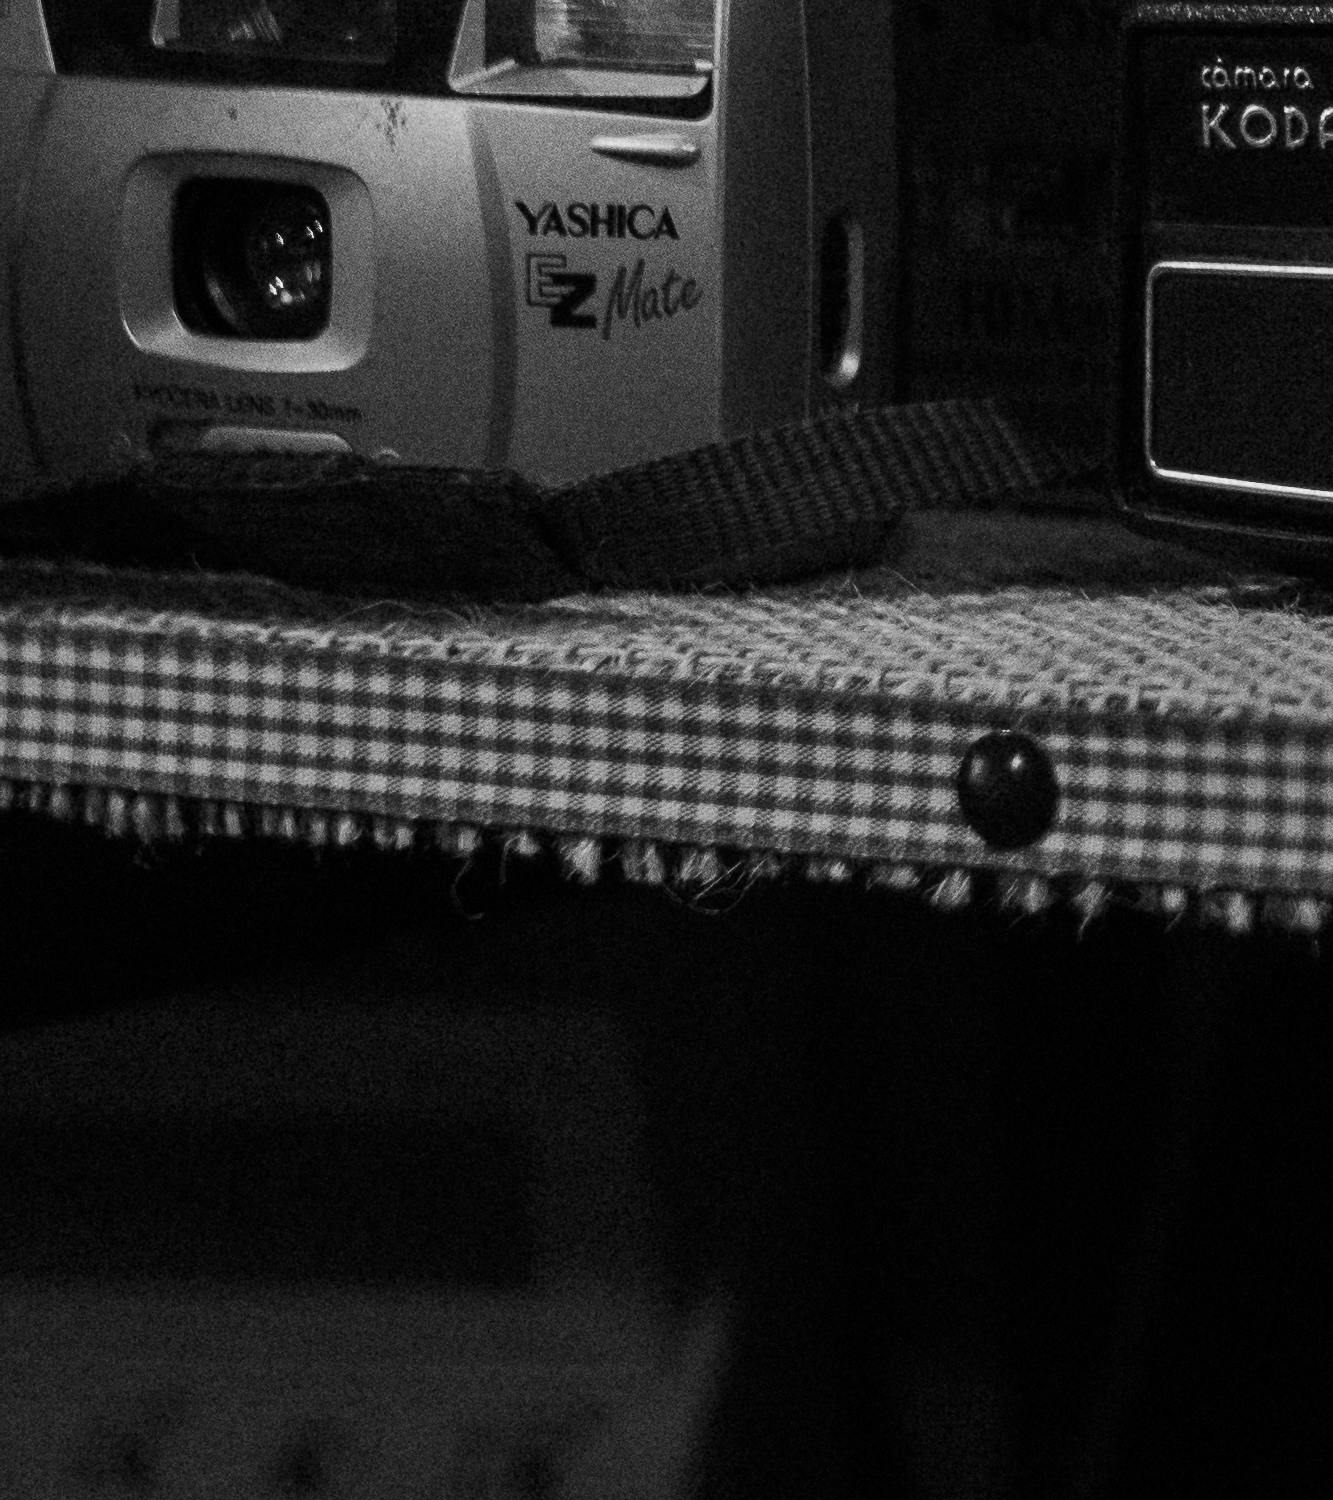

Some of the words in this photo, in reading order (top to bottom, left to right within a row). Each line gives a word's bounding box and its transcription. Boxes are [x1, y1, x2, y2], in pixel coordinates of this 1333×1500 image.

[515, 201, 679, 240] YASHICA
[526, 253, 597, 327] EZ
[602, 257, 702, 340] Mate
